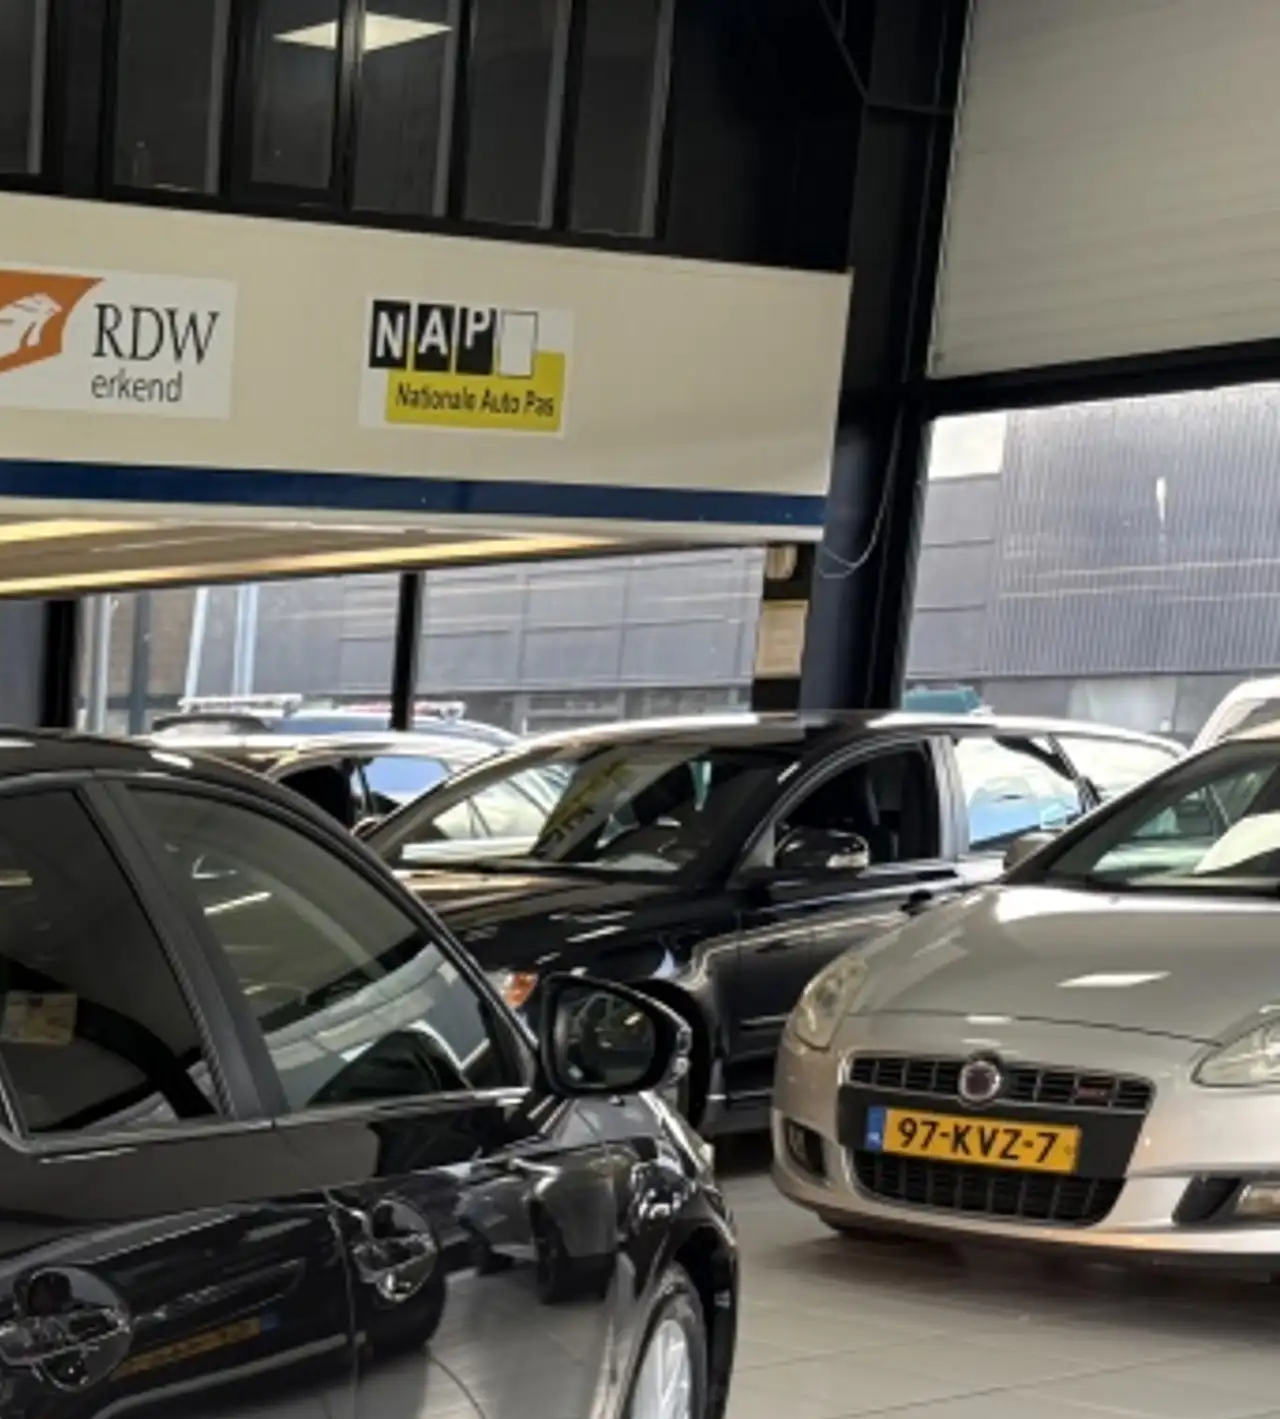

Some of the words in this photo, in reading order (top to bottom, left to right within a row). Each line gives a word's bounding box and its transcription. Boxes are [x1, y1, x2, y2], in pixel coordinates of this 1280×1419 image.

[91, 302, 220, 364] RDW
[375, 307, 490, 359] NAP
[91, 368, 182, 402] erkend
[395, 382, 476, 411] Nationale
[480, 389, 520, 414] Auto
[897, 1116, 1060, 1163] 97-KVZ-7
